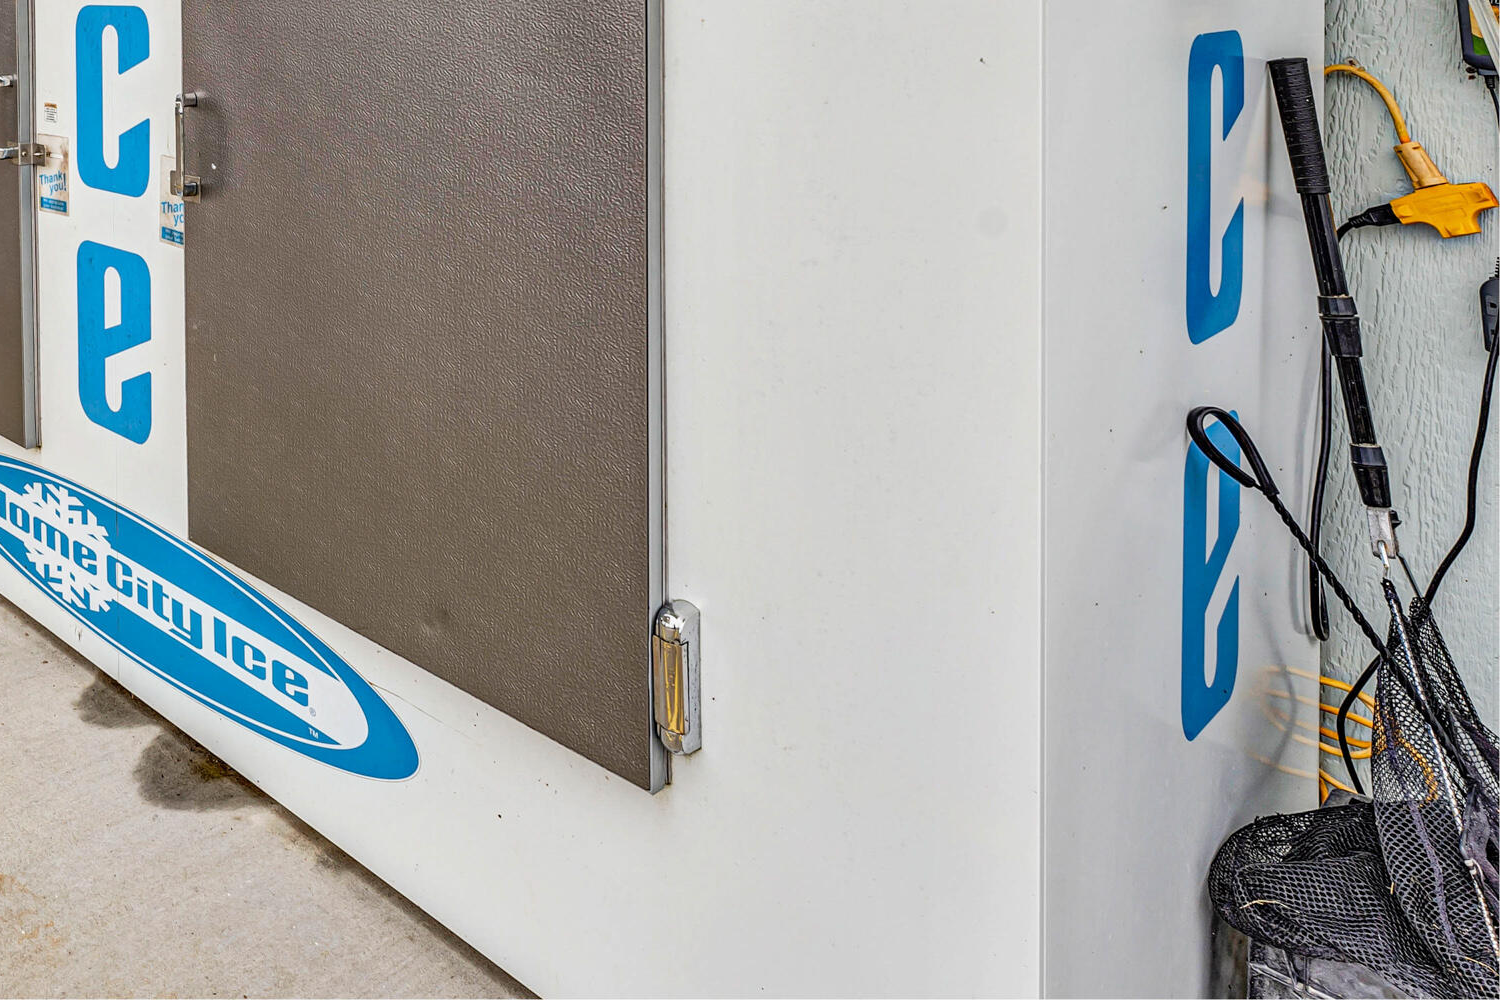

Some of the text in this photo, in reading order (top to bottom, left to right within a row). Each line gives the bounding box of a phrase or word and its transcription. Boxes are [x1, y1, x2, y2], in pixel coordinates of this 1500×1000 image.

[39, 170, 62, 184] Thank
[50, 173, 66, 196] you!
[161, 201, 184, 213] Than
[107, 555, 202, 650] City
[213, 620, 309, 707] Ice
